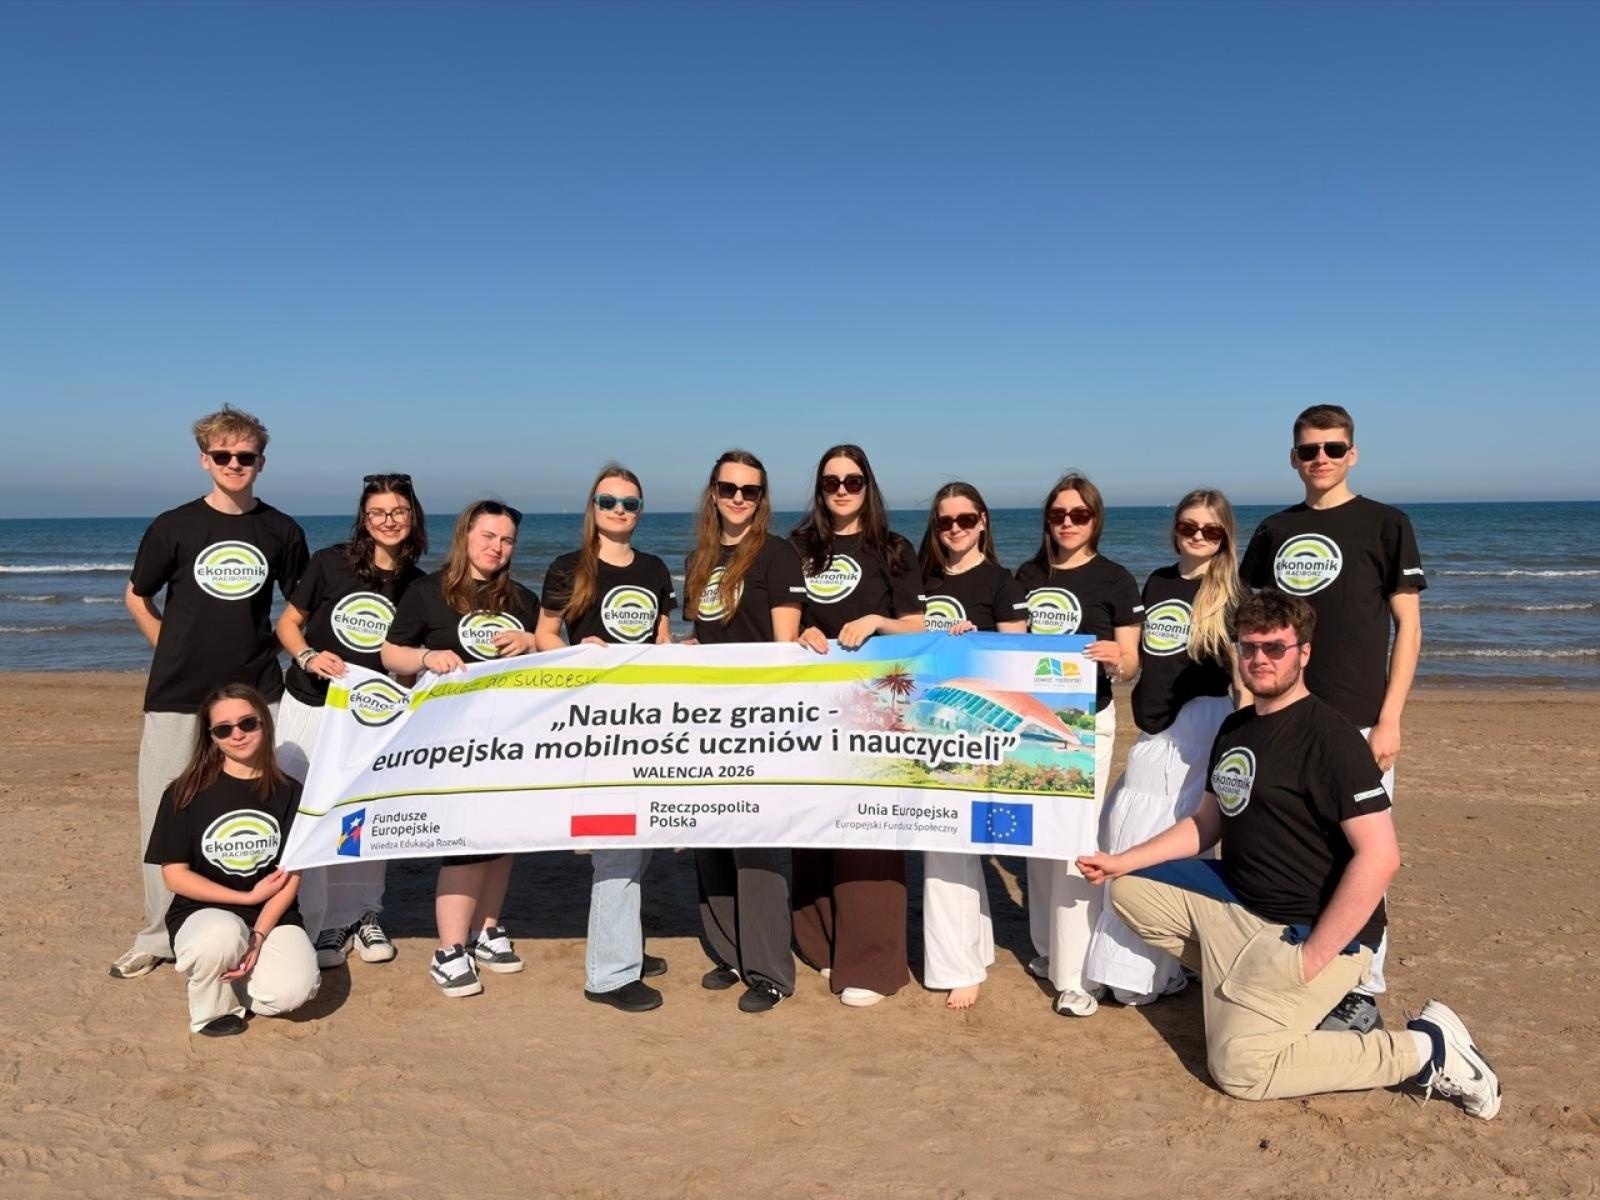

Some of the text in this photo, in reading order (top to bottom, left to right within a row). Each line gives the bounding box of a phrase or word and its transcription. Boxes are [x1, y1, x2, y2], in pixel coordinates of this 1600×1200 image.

[197, 565, 266, 576] ekonomik
[1031, 610, 1078, 623] onomik
[672, 702, 722, 724] bez
[730, 701, 820, 729] granic
[372, 737, 524, 771] europejska
[534, 732, 690, 759] mobilność
[699, 730, 822, 755] uczniów
[832, 729, 839, 751] i
[633, 765, 755, 778] WALENCJA 2026
[650, 801, 760, 815] Rzeczpospolita
[857, 803, 958, 819] Unia Europejska
[372, 811, 427, 824] Fundusze
[650, 816, 697, 827] Polska
[371, 822, 441, 836] Europejskie
